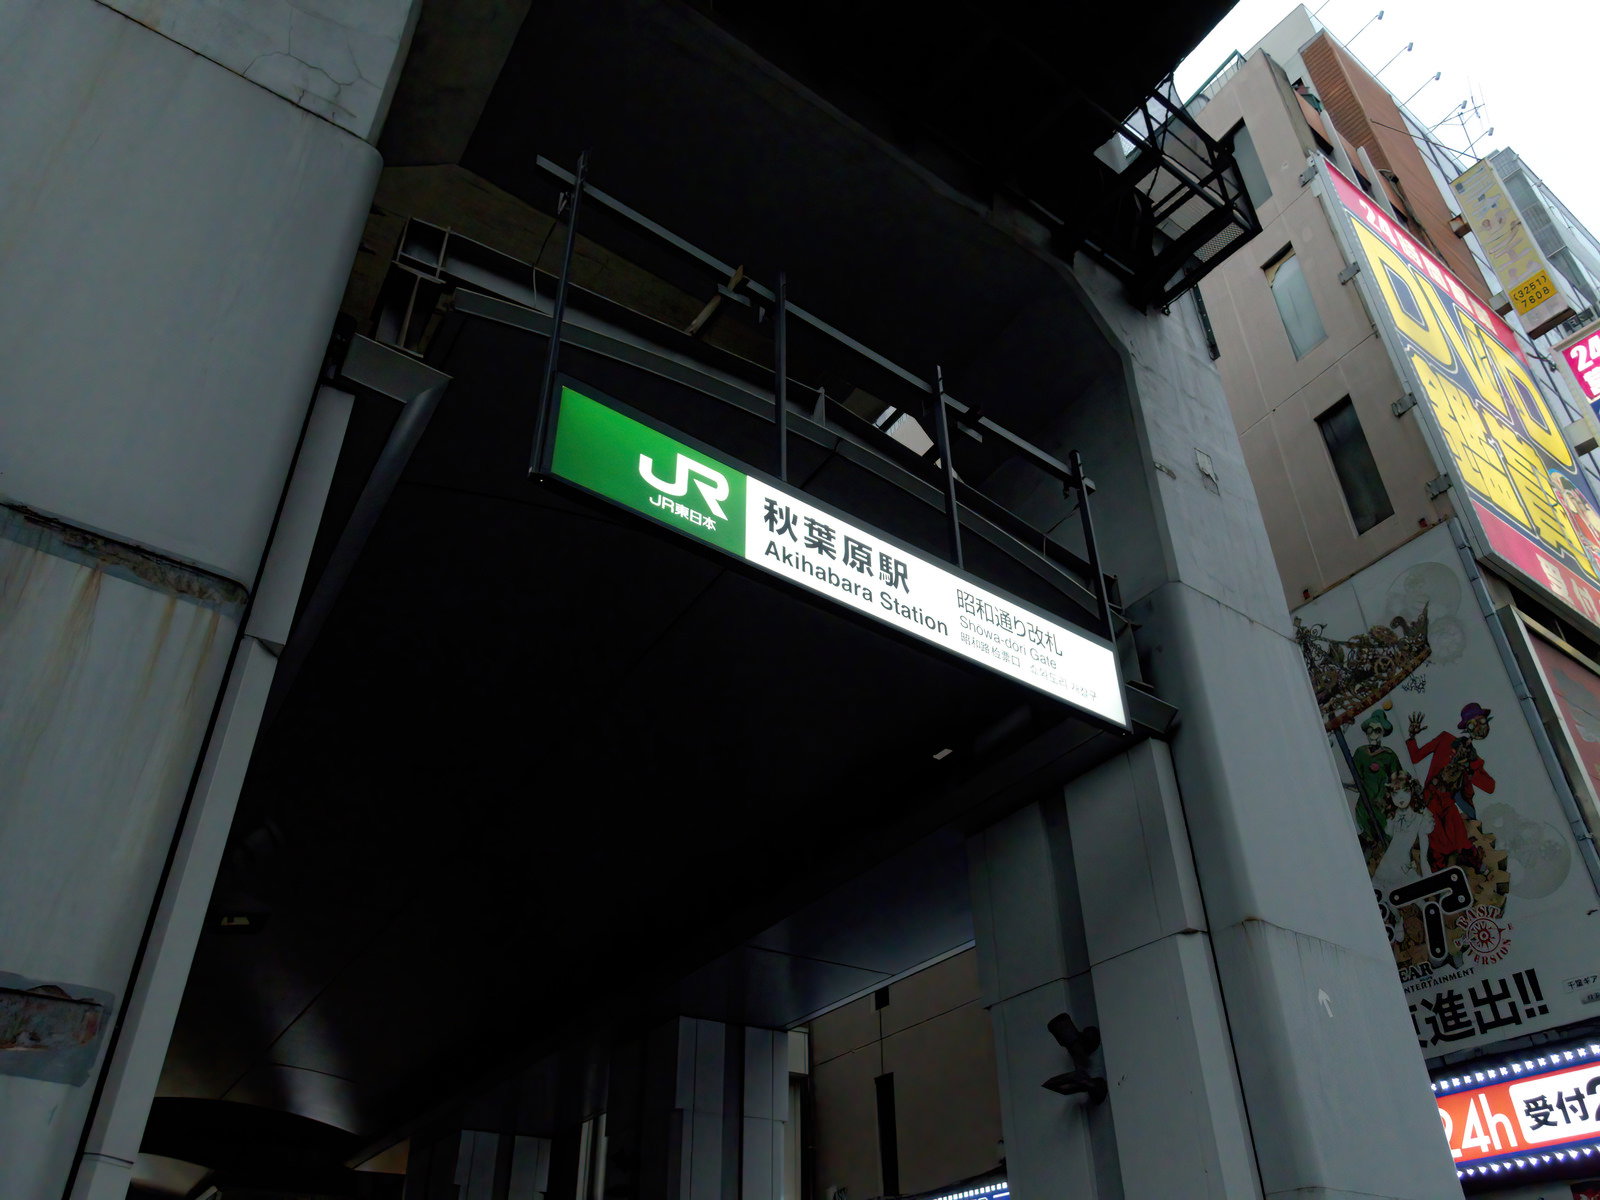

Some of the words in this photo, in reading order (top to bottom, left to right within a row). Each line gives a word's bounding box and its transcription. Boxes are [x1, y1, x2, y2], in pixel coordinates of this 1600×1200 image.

[1513, 275, 1548, 301] (3251)
[1350, 217, 1574, 467] DVD
[638, 452, 730, 521] JR
[649, 494, 717, 532] JR東日本
[763, 497, 910, 595] 秋葉原駅
[764, 540, 873, 603] Akihabara
[880, 591, 949, 636] Station
[956, 588, 1063, 657] 昭和通り改札
[959, 615, 1027, 656] Showa-dori
[1030, 647, 1058, 670] Gate
[1408, 968, 1550, 1048] 進出!!
